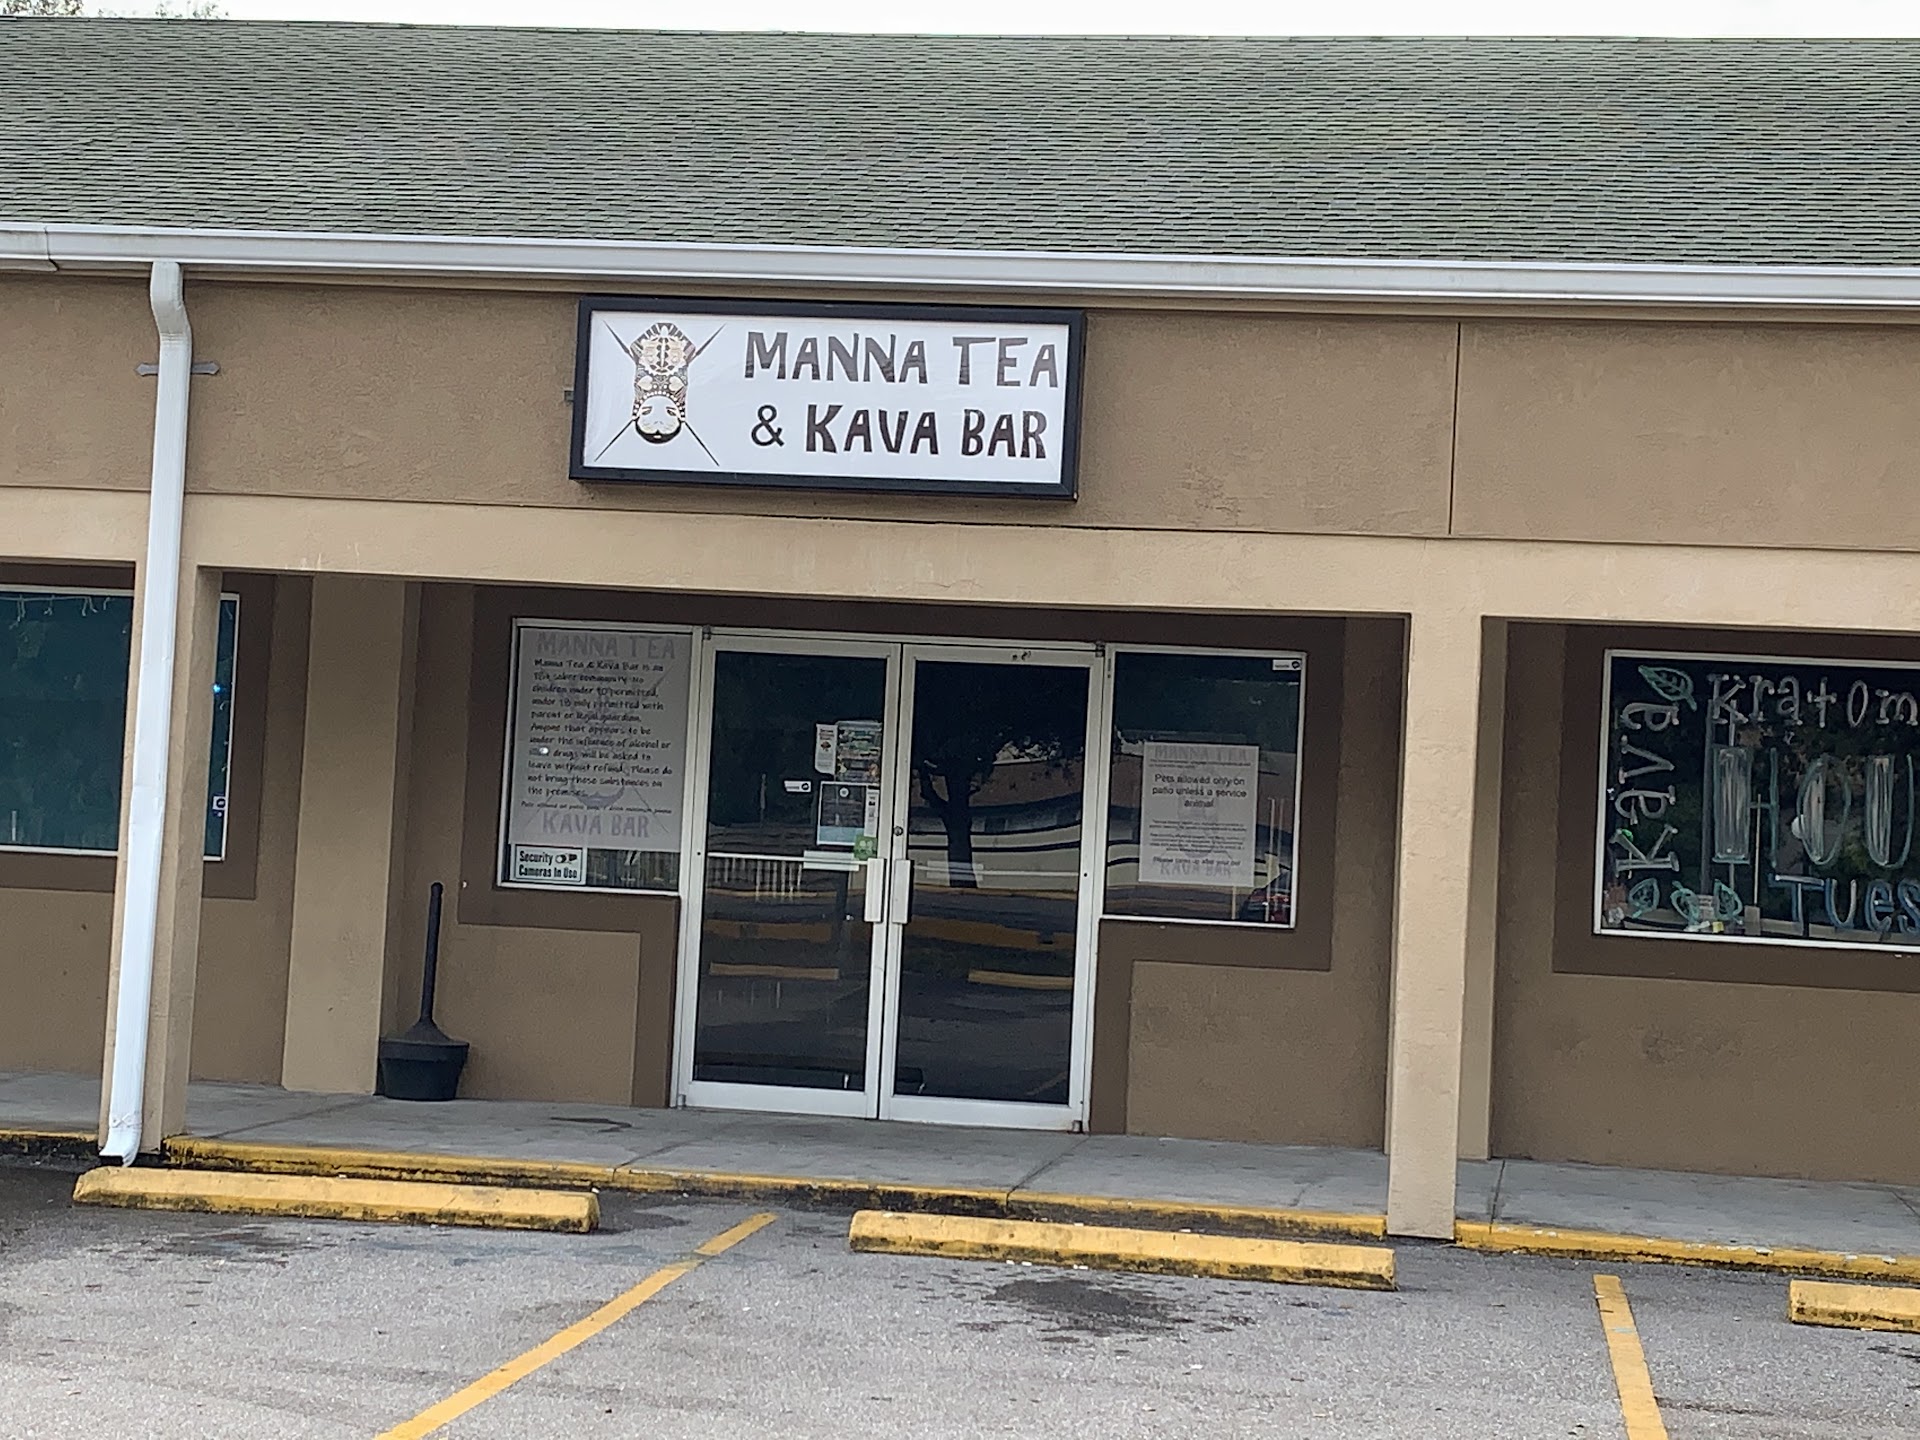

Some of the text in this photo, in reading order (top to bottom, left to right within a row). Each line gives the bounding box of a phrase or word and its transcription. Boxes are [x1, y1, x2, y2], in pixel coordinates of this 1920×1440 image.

[744, 330, 1060, 388] MANNA TEA
[750, 403, 1048, 460] & KAVA BAR
[1154, 773, 1175, 783] Pets
[1177, 774, 1210, 784] allowed
[1176, 786, 1204, 796] unless
[1207, 788, 1213, 796] a
[1216, 788, 1247, 798] service
[542, 810, 650, 838] KAVA BAR
[519, 850, 553, 866] Security
[519, 864, 552, 878] Cameras
[563, 867, 578, 879] Use
